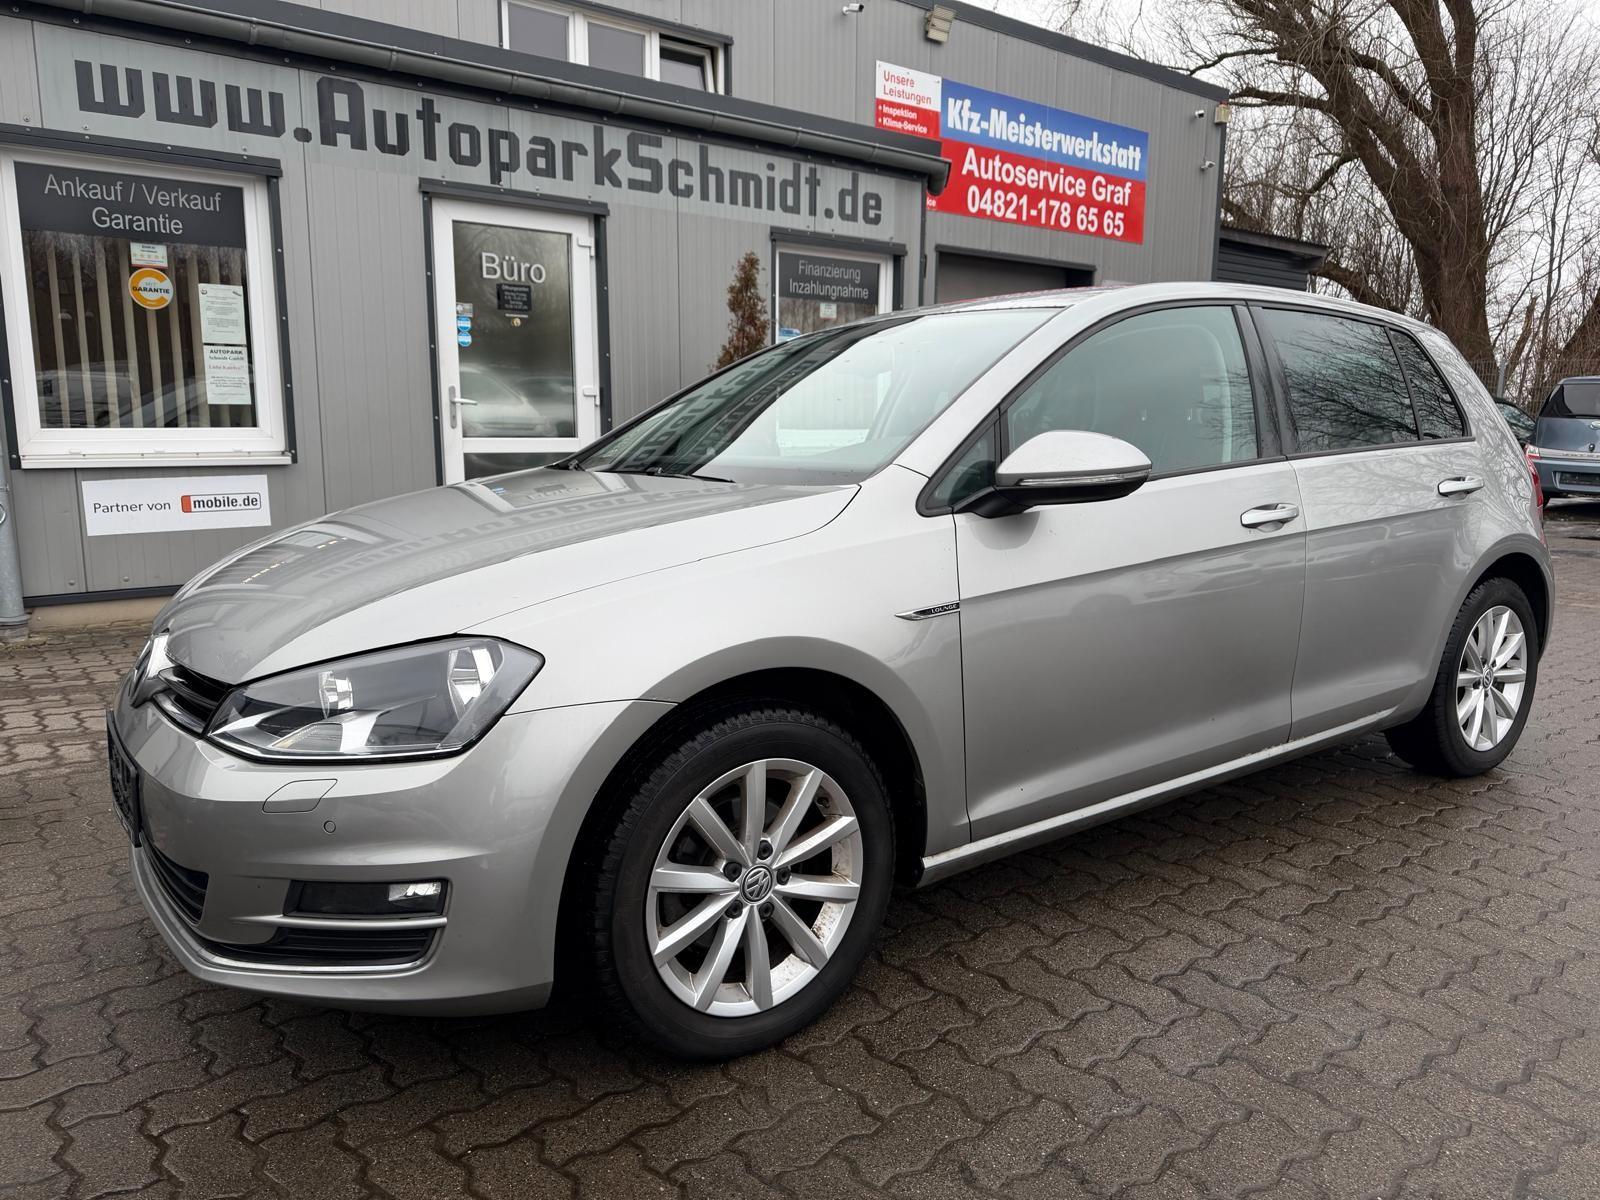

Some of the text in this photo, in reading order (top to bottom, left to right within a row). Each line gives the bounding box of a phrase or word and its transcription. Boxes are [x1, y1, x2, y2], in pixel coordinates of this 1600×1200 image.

[883, 70, 915, 88] Unsere
[883, 85, 932, 105] Leistungen
[882, 103, 918, 120] Inspektion
[882, 117, 928, 134] Klima-Service
[947, 97, 1141, 172] Kfz-Meisterwerkstatt
[74, 59, 883, 226] www.AutoparkSchmidt.de
[961, 147, 1132, 207] Autoservice Graf
[44, 173, 123, 202] Ankauf
[141, 183, 222, 212] Verkauf
[92, 206, 183, 235] Garantie
[967, 185, 1125, 237] 04821-178 65 65
[481, 251, 546, 283] Büro
[798, 260, 861, 283] Finanzierung
[132, 286, 170, 294] GARANTIE
[789, 278, 869, 300] Inzahlungnahme
[93, 495, 258, 514] Partner von mobile.de
[931, 603, 957, 614] LOUNGE
